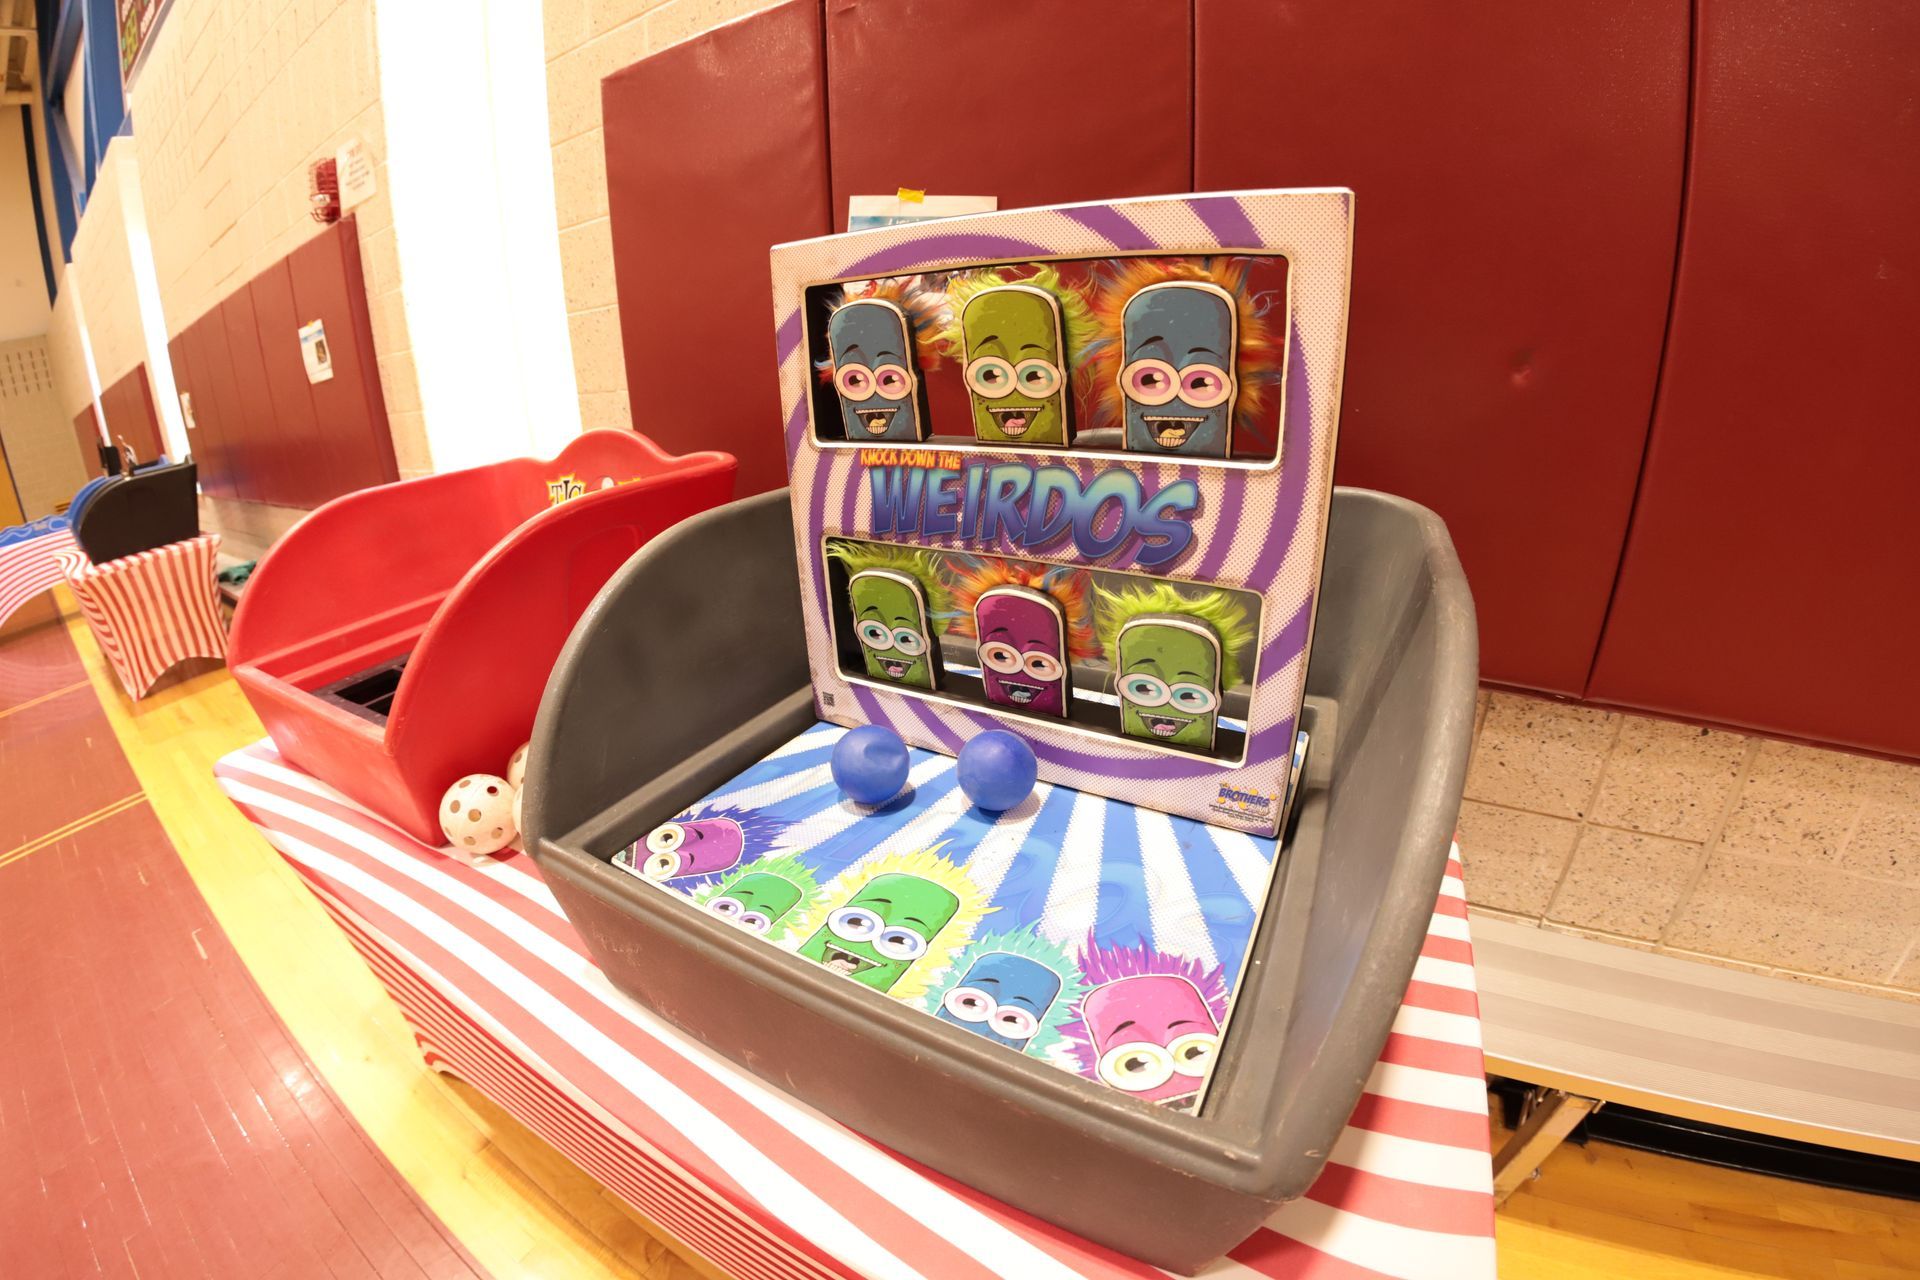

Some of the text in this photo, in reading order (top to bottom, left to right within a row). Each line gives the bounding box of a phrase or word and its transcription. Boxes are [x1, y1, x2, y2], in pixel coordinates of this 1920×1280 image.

[860, 448, 962, 470] KNOCK DOWN THE
[870, 462, 1199, 566] WEIRDOS
[1218, 788, 1270, 807] BROTHERS
